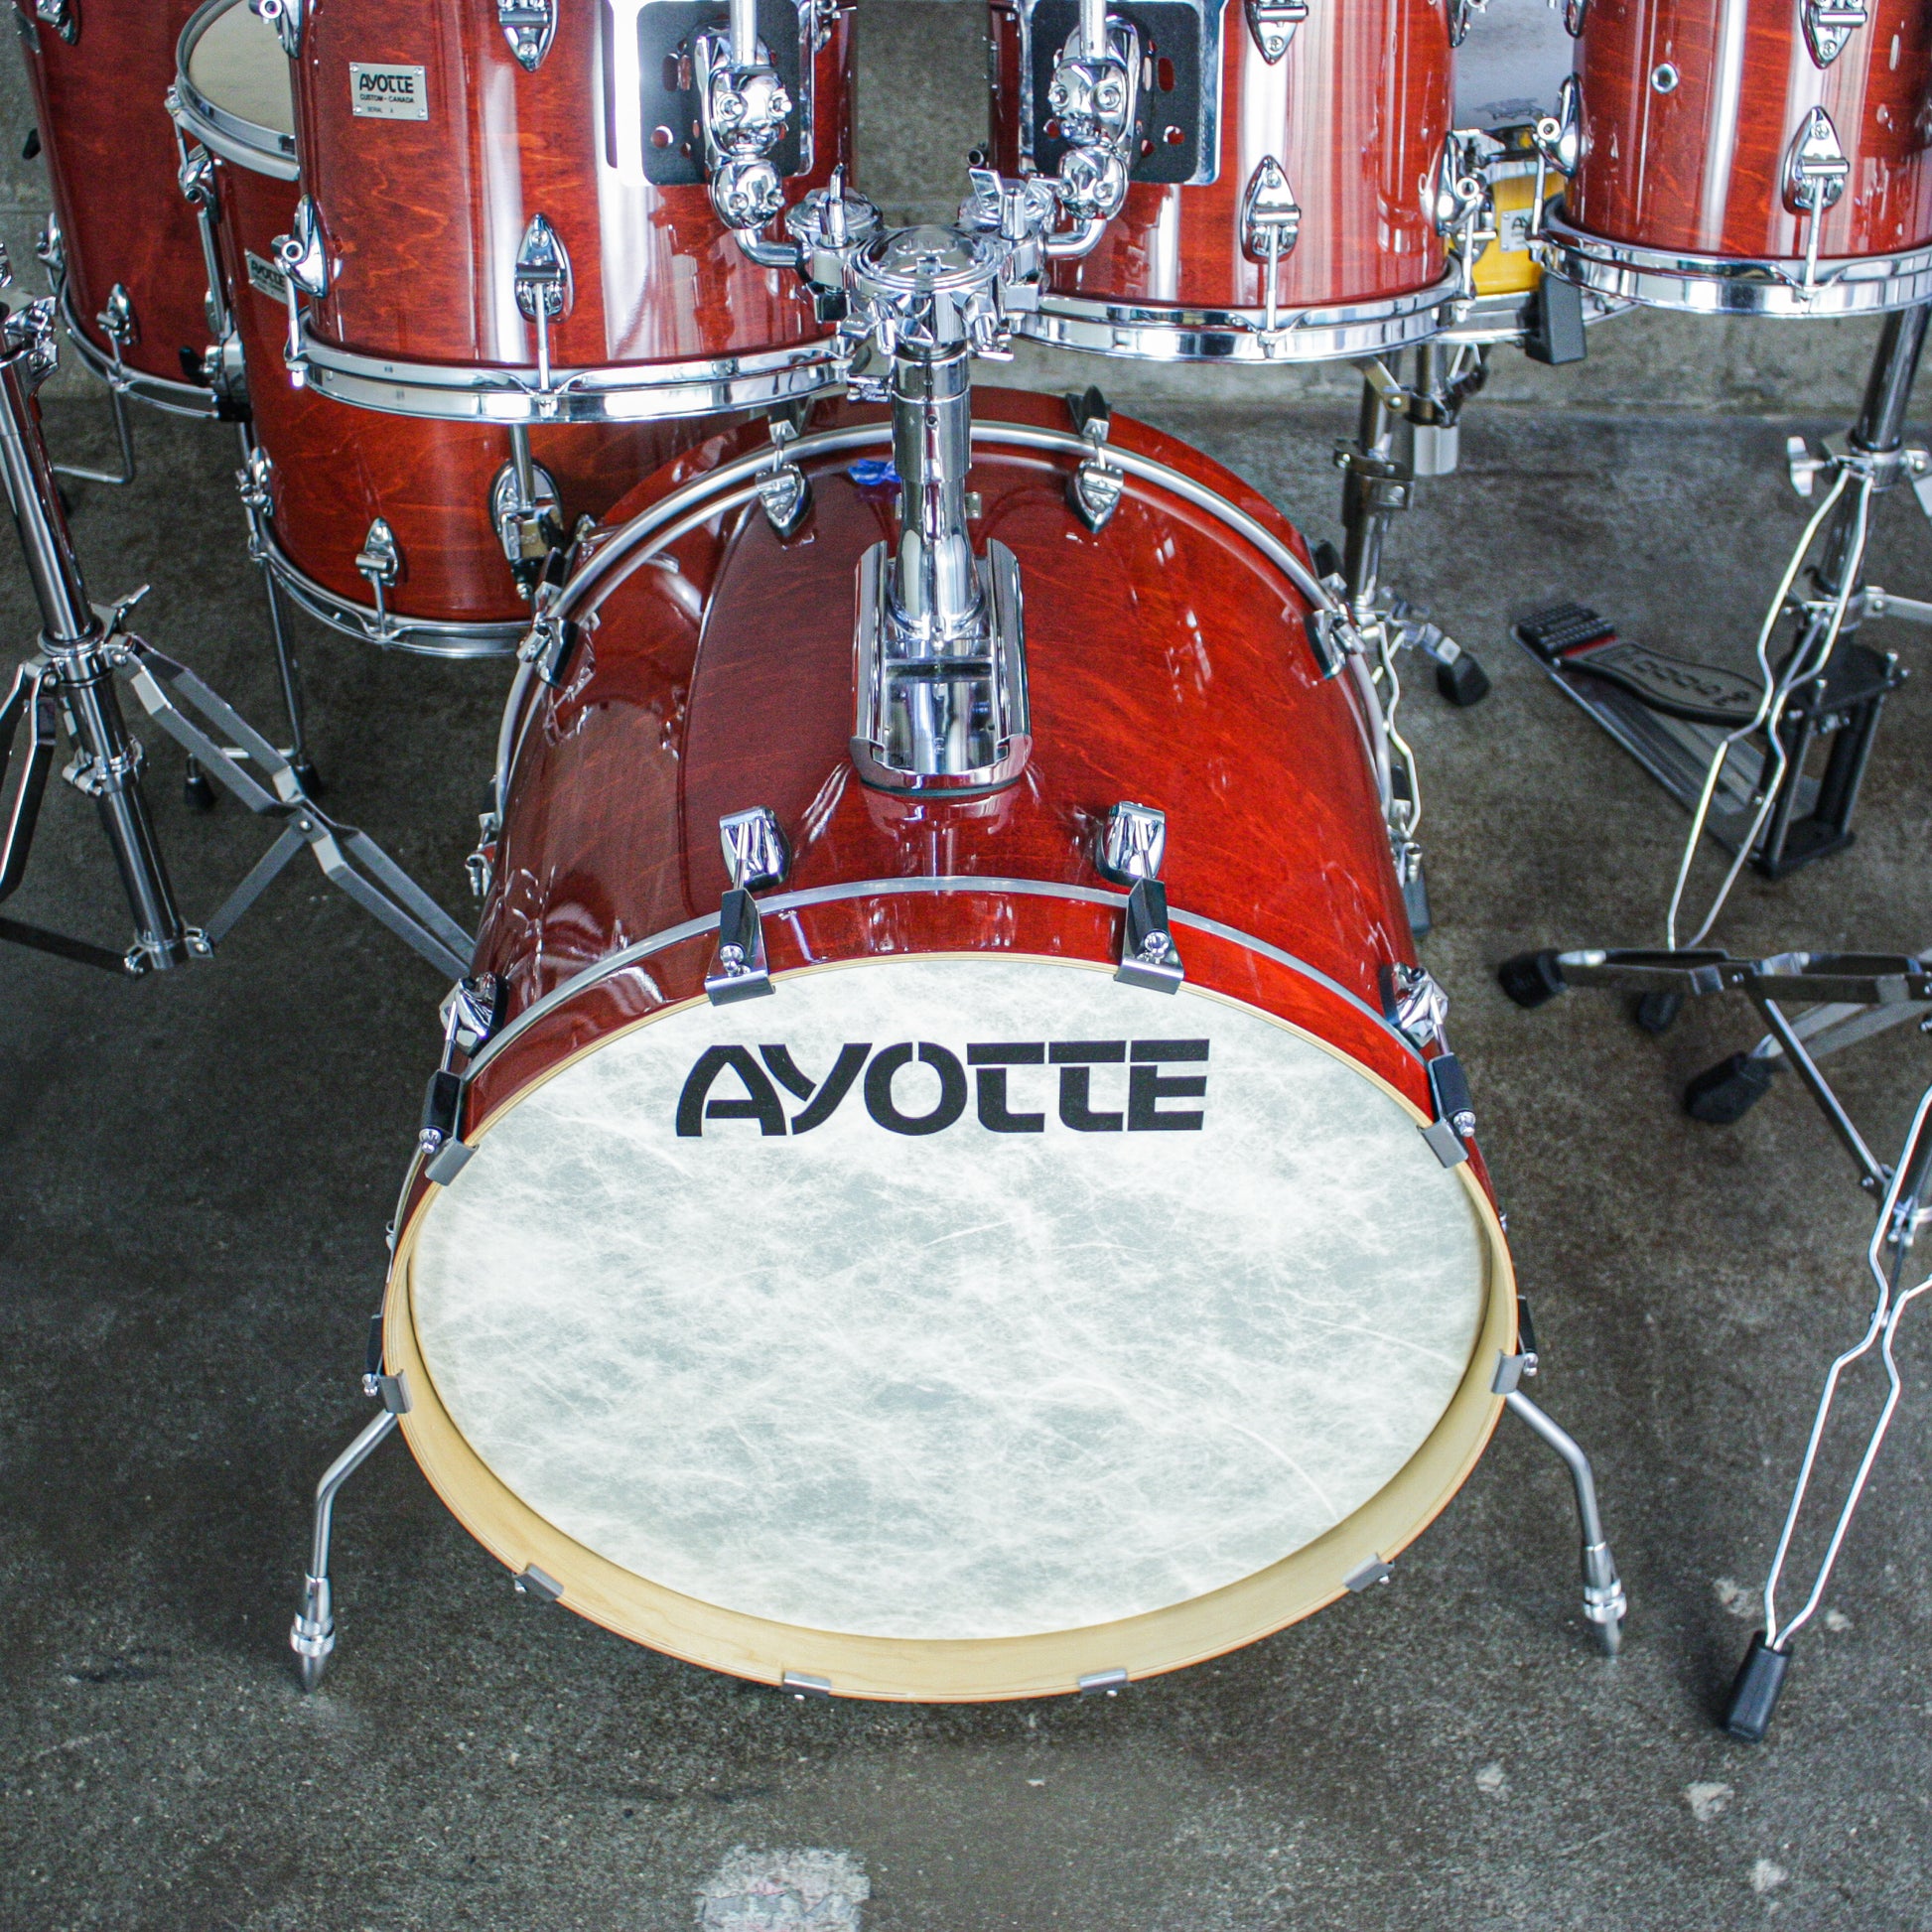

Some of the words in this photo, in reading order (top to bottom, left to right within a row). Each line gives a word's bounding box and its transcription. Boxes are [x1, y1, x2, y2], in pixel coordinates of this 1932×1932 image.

[359, 73, 414, 93] AYOTTE
[359, 93, 383, 102] CUSTOM
[388, 95, 414, 104] CANADA
[676, 1038, 1210, 1138] AYOTTE
